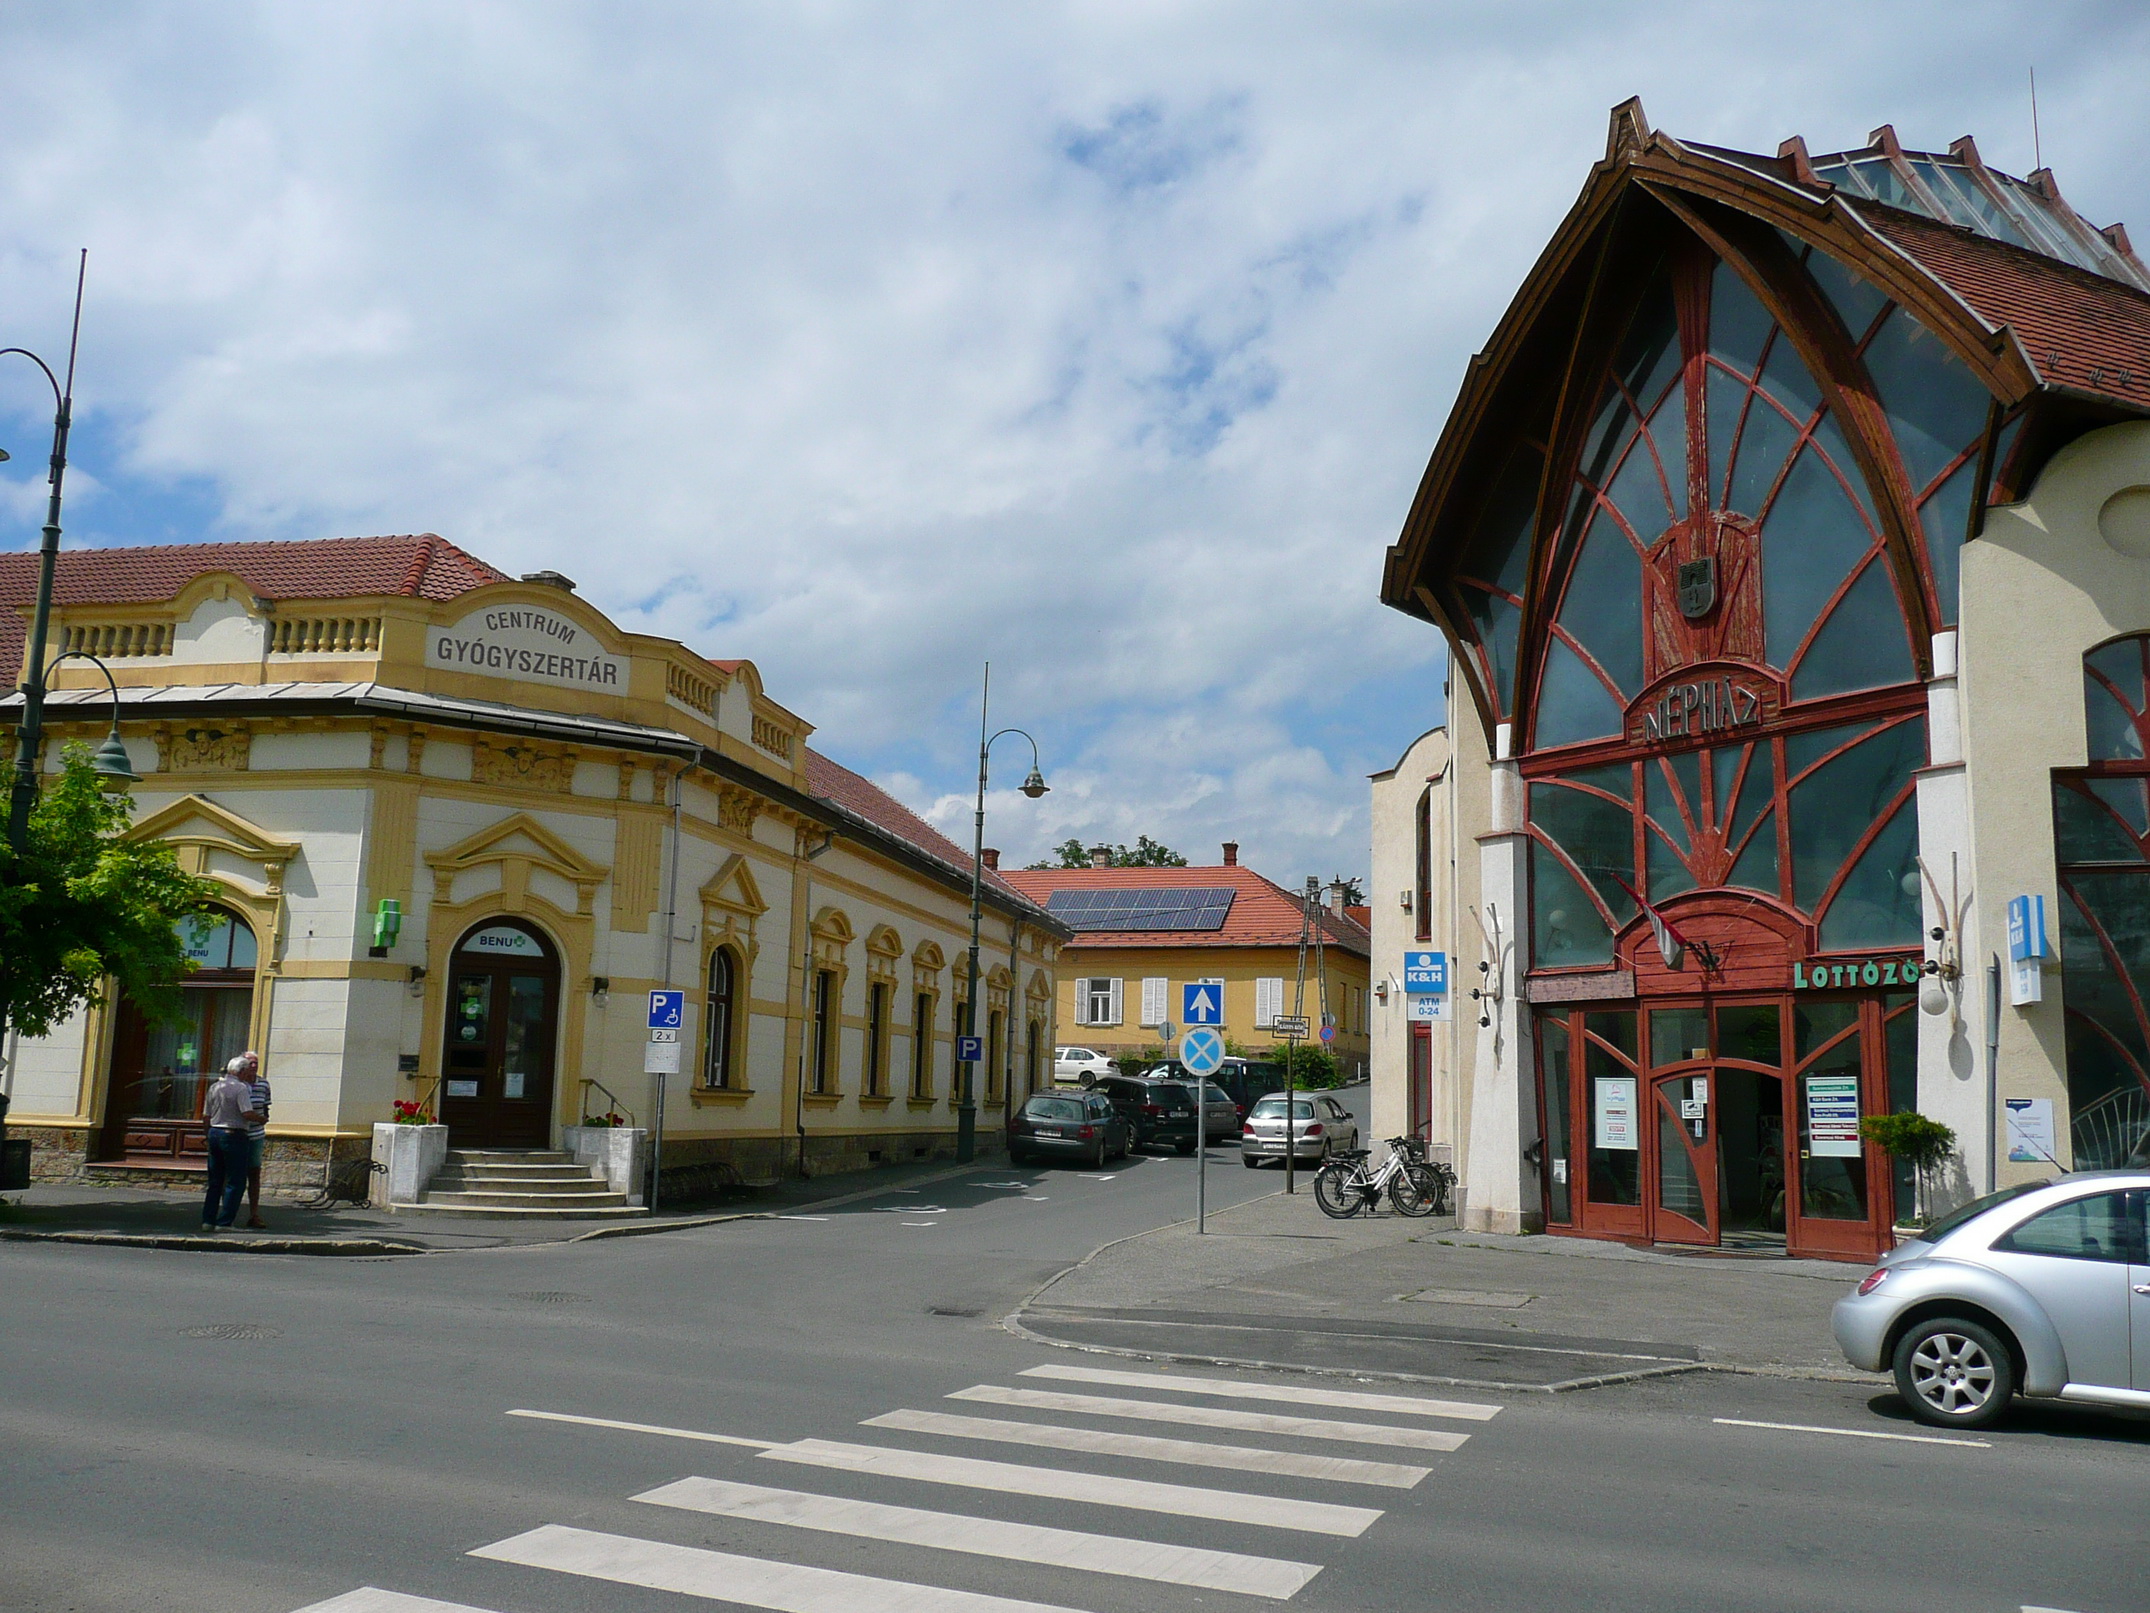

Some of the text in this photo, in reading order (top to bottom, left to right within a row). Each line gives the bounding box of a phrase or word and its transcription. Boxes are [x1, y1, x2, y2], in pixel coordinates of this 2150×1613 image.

[485, 611, 576, 645] CENTRUM
[437, 637, 617, 685] GYÓGYSZERTÁR
[1644, 675, 1757, 741] NÉPHÁZ
[479, 935, 513, 948] BENU
[188, 949, 209, 957] BENU
[1408, 972, 1442, 982] K&H
[1794, 958, 1920, 988] LOTTÓZÓ
[652, 994, 667, 1014] P
[1418, 1007, 1440, 1015] 0-24
[656, 1031, 663, 1041] 2
[962, 1039, 978, 1058] P
